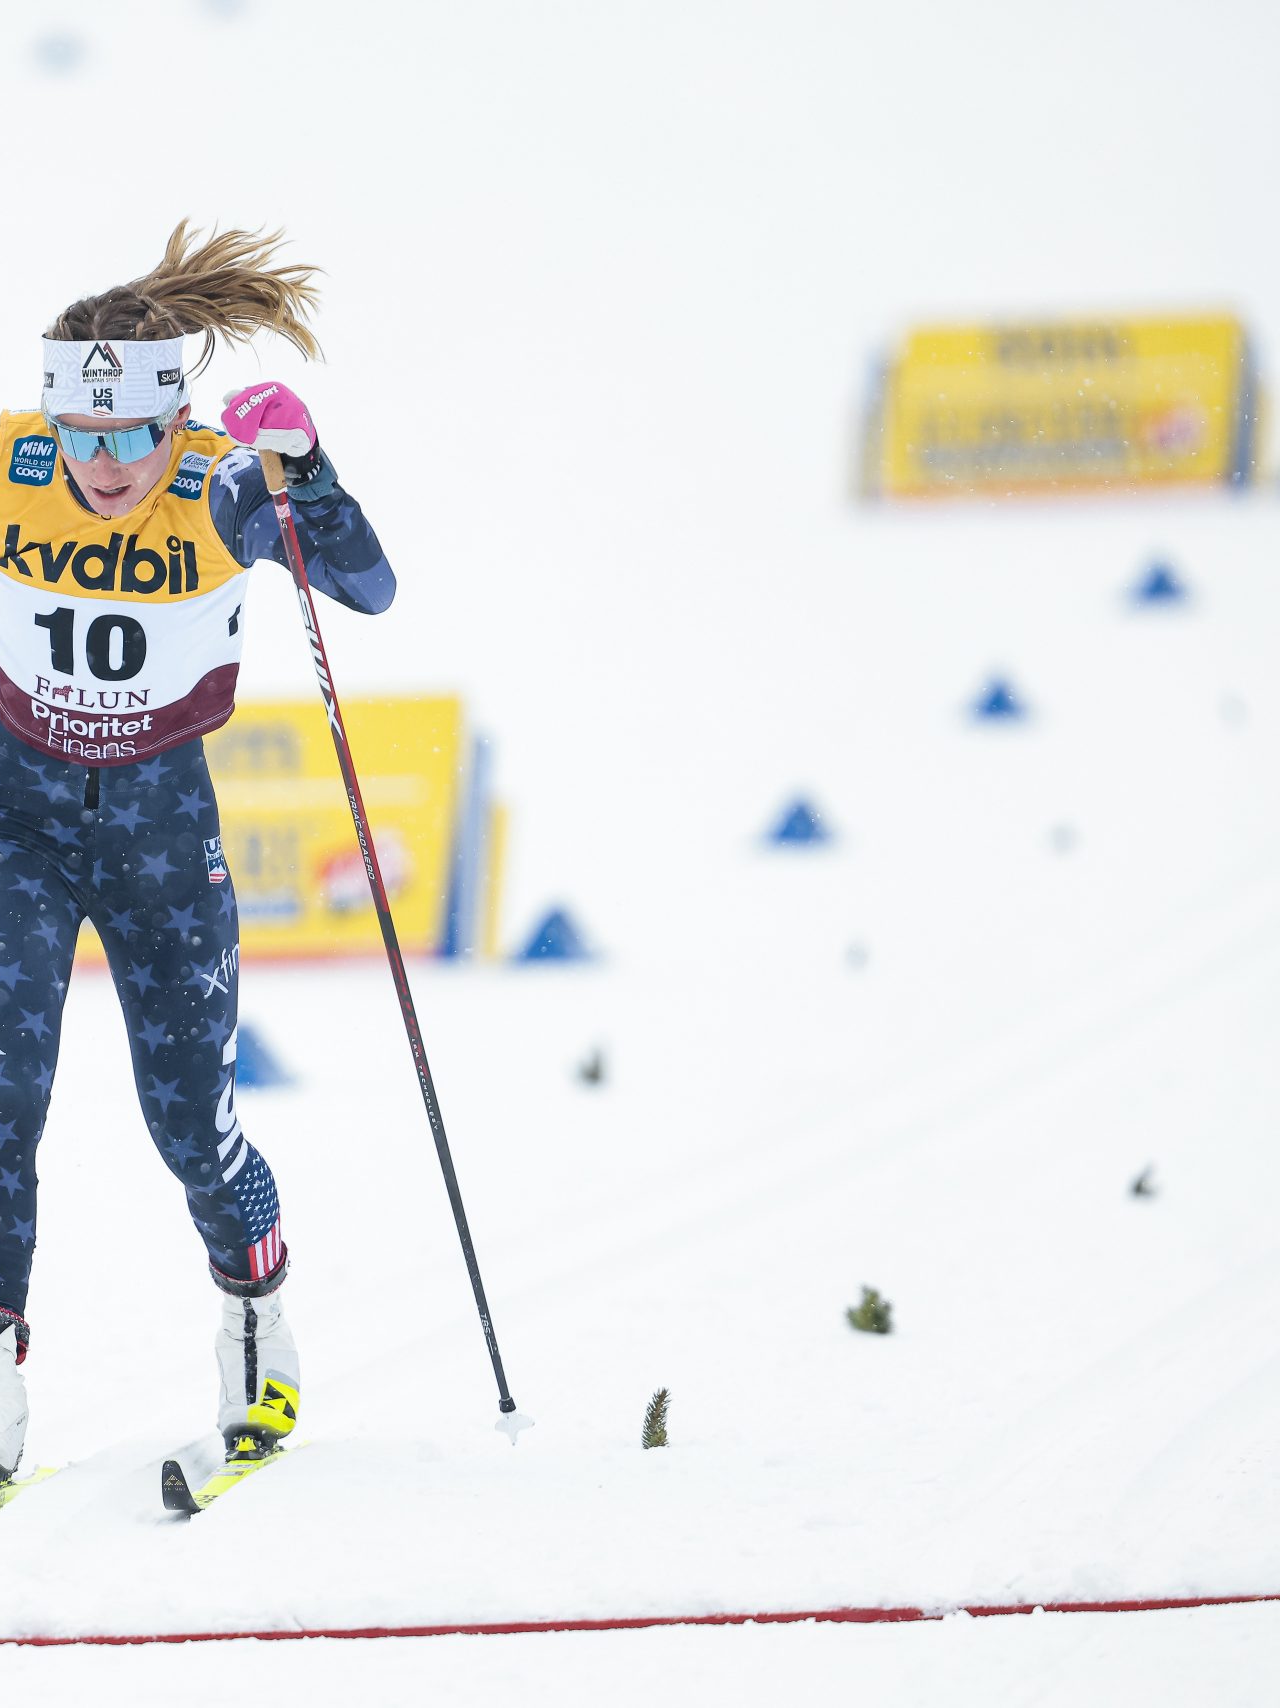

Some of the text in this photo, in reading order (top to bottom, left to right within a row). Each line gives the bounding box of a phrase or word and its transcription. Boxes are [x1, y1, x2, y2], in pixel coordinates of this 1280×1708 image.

[81, 368, 123, 378] WINTHROP
[160, 370, 181, 383] SKIDA
[92, 388, 113, 399] US
[14, 456, 53, 467] WORLD CUP
[15, 466, 48, 481] coop
[34, 607, 147, 682] 10
[31, 700, 153, 739] Prioritet
[47, 727, 136, 760] Finans
[349, 795, 362, 829] TRIAC
[362, 847, 375, 880] AERO
